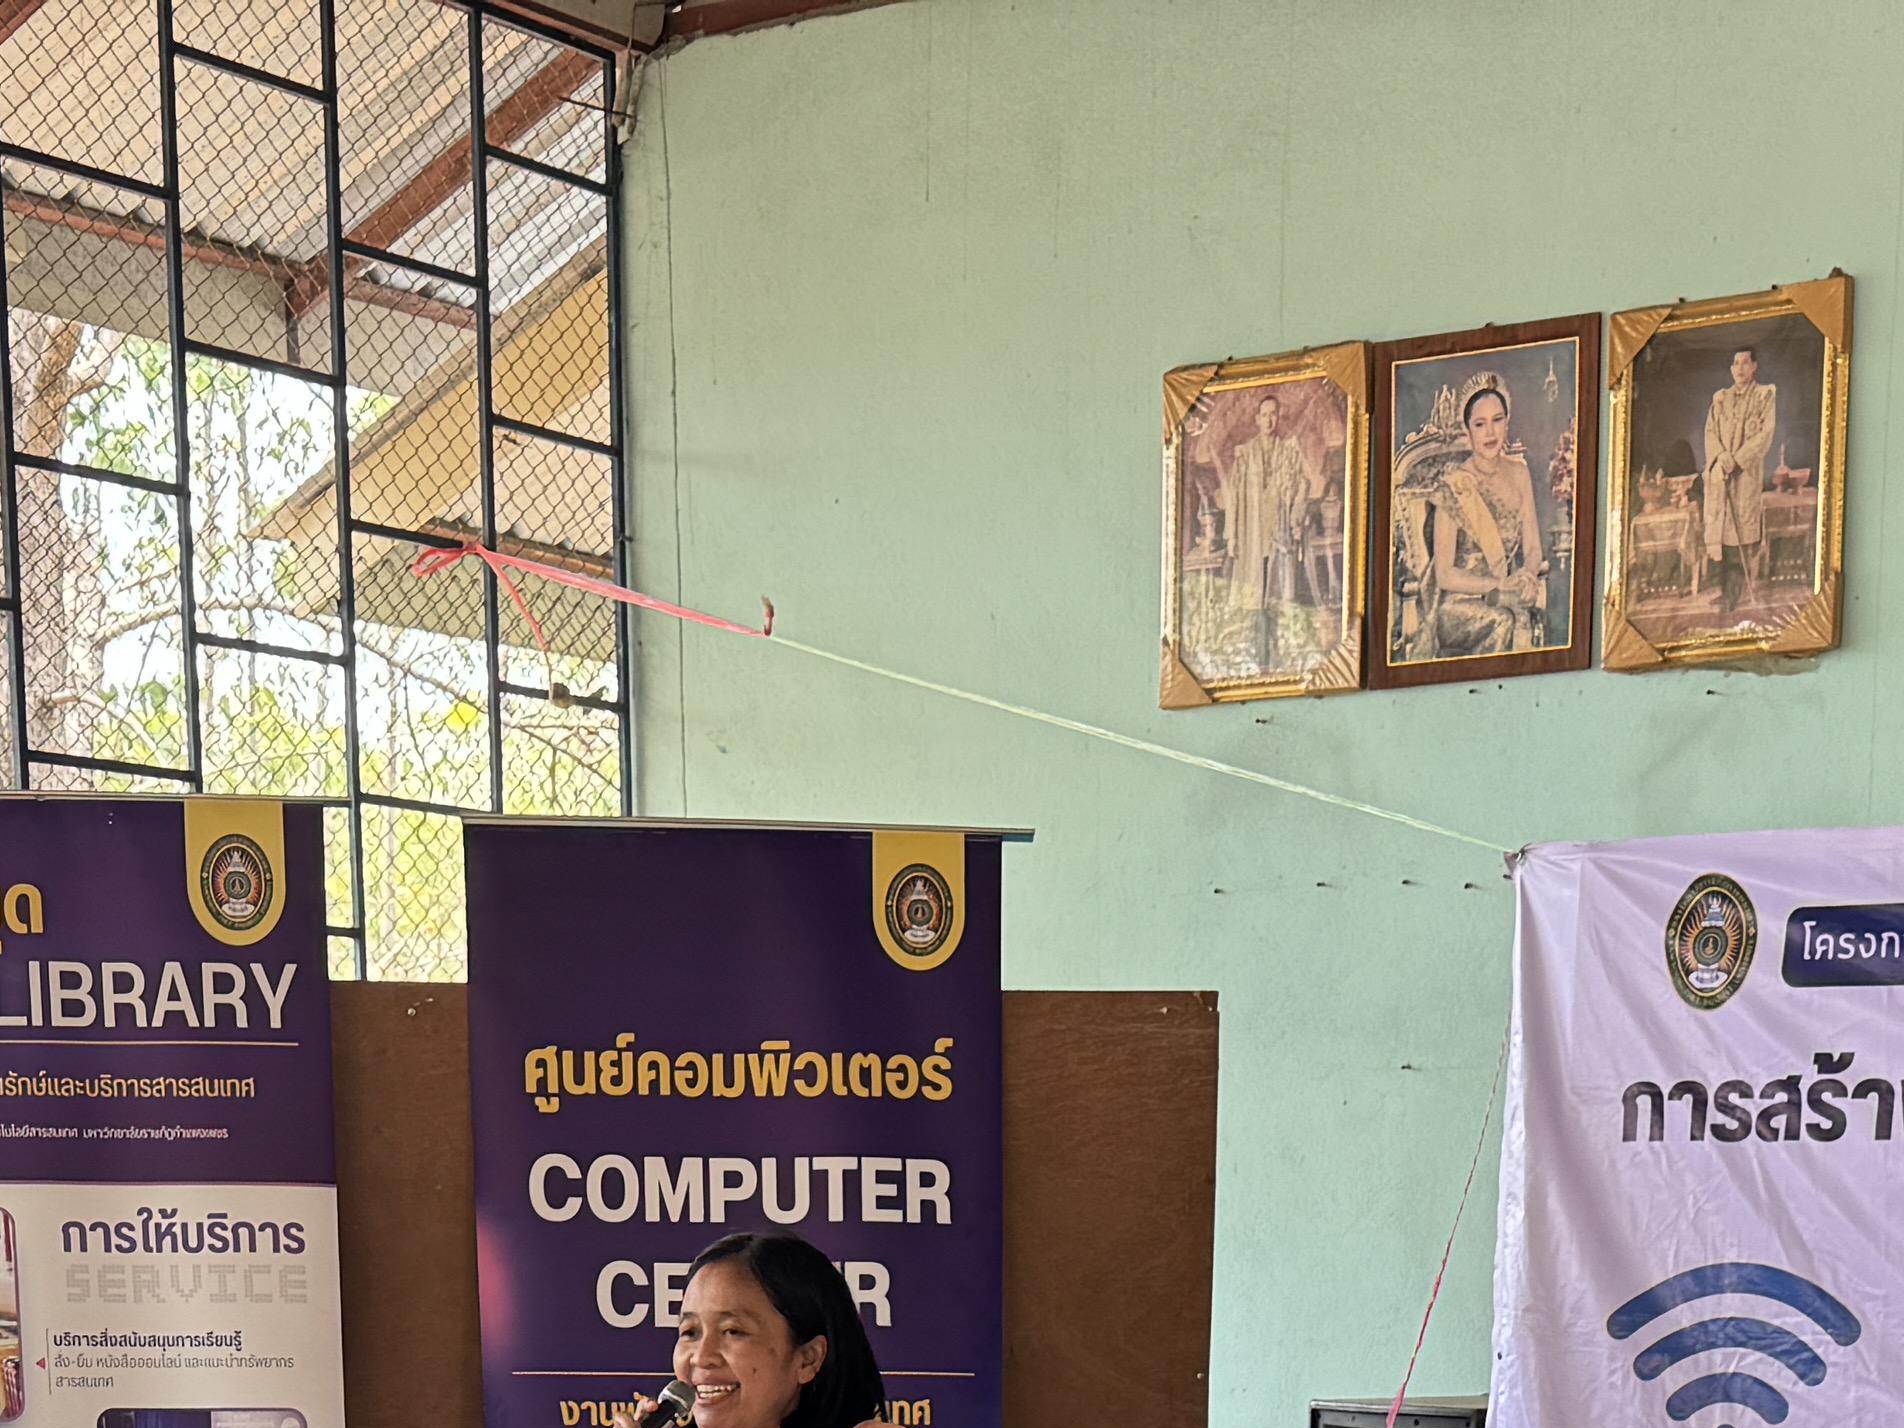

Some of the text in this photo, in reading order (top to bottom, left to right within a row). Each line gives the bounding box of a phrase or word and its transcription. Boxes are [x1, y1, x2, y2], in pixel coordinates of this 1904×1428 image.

[524, 1032, 954, 1113] ศูนย์คอมพิวเตอร์
[528, 1153, 952, 1225] COMPUTER
[61, 1207, 306, 1255] การให้บริการ
[65, 1263, 308, 1304] SERVICE
[53, 1328, 242, 1352] บริการสิ่งสนับสนุนการเรียนรู้
